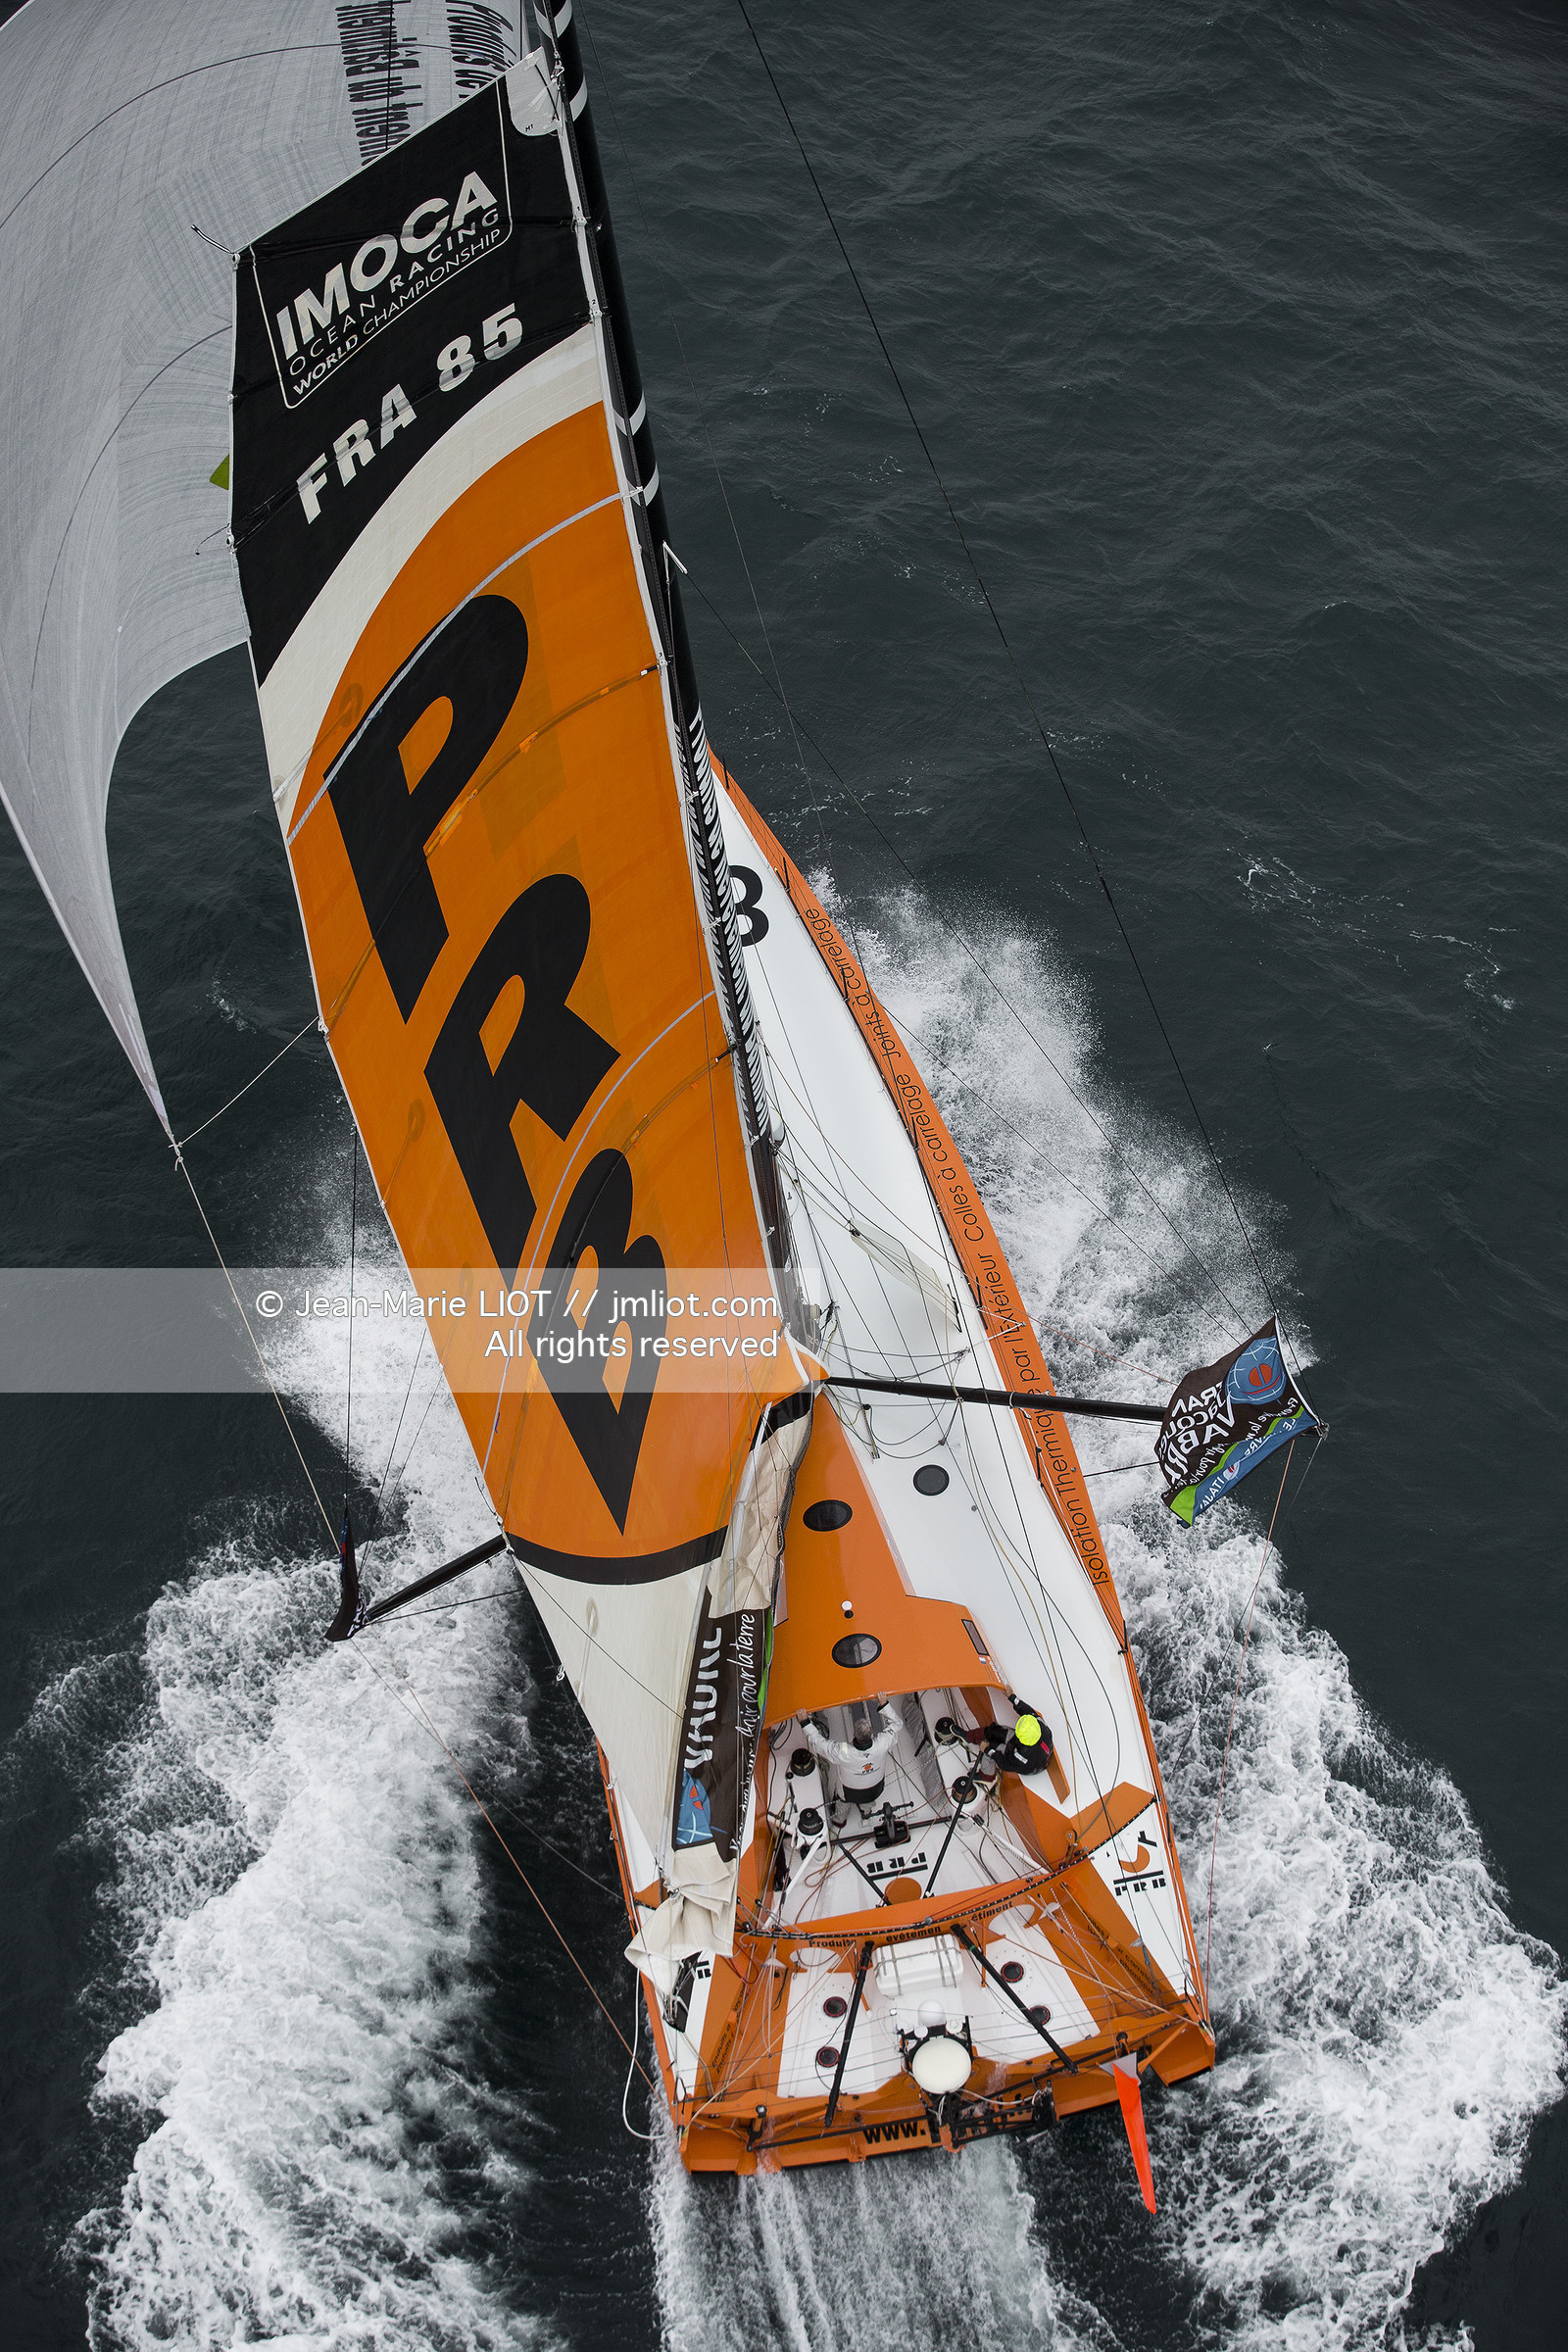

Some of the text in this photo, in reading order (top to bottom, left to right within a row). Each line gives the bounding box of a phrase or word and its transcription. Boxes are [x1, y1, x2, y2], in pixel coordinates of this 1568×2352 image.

[276, 171, 498, 361] IMOCA
[289, 208, 500, 375] OCEAN RACING
[293, 227, 502, 396] WORLD CHAMPIONSHIP
[296, 302, 523, 524] FRA 85
[806, 907, 861, 990] carrelage
[323, 594, 666, 1536] PRB
[865, 1011, 901, 1059] Joints
[896, 1073, 984, 1242] Colles à carrelage
[1011, 1348, 1041, 1383] par
[1028, 1388, 1075, 1495] Thermiqe
[1066, 1498, 1110, 1587] Isolation
[885, 1925, 942, 1943] evêtemen
